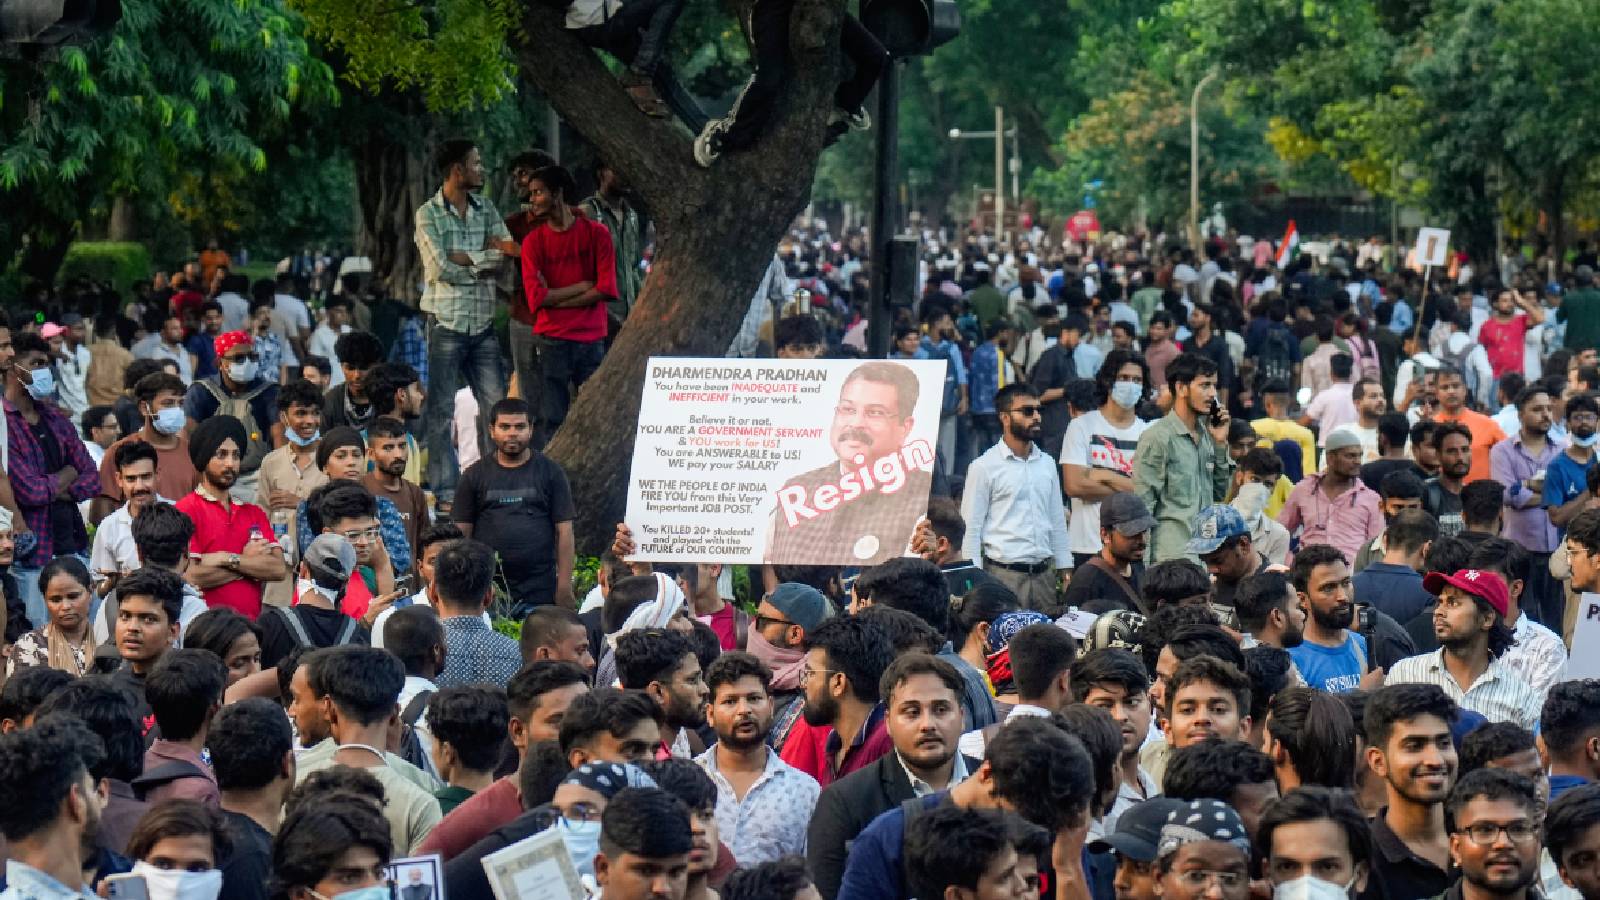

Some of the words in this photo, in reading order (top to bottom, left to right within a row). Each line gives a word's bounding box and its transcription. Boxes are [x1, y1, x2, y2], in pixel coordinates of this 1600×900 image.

[652, 366, 752, 380] DHARMENDRA
[755, 368, 828, 381] PRADHAN
[654, 381, 673, 391] You
[675, 381, 701, 391] have
[703, 382, 729, 391] been
[731, 383, 798, 394] INADEQUATE
[800, 384, 821, 394] and
[668, 392, 730, 402] INEFFICIENT
[732, 394, 741, 403] in
[744, 396, 769, 405] your
[771, 395, 802, 404] work.
[689, 415, 726, 425] Believe
[728, 415, 736, 424] it
[738, 417, 750, 425] or
[640, 425, 662, 434] YOU
[664, 425, 687, 435] ARE
[687, 426, 696, 435] A
[698, 426, 774, 437] GOVERNMENT
[775, 428, 825, 438] SERVANT
[678, 436, 687, 445] &
[689, 437, 712, 446] YOU
[714, 437, 741, 447] work
[745, 438, 760, 447] for
[763, 439, 781, 448] US!
[655, 447, 673, 456] You
[695, 448, 768, 459] ANSWERABLE
[770, 450, 781, 459] to
[784, 450, 801, 460] US!
[668, 459, 685, 468] WE
[686, 461, 707, 471] pay
[710, 462, 735, 471] your
[736, 460, 780, 470] SALARY
[639, 479, 656, 490] WE
[657, 480, 677, 490] THE
[680, 481, 718, 491] PEOPLE
[720, 482, 737, 491] OF
[738, 482, 767, 492] INDIA
[776, 439, 936, 528] Resign
[641, 490, 662, 500] FIRE
[664, 491, 688, 501] YOU
[690, 491, 715, 501] from
[717, 492, 736, 502] this
[738, 493, 763, 505] Very
[646, 501, 698, 514] Important
[700, 503, 721, 513] JOB
[723, 504, 753, 514] POST.
[642, 524, 658, 533] You
[660, 525, 691, 534] KILLED
[693, 526, 711, 534] 20+
[713, 527, 755, 536] students!
[652, 535, 670, 544] and
[672, 536, 703, 547] played
[704, 536, 724, 544] with
[727, 536, 741, 544] the
[641, 543, 674, 553] FUTURE
[675, 544, 685, 554] of
[686, 545, 706, 554] OUR
[708, 546, 753, 555] COUNTRY
